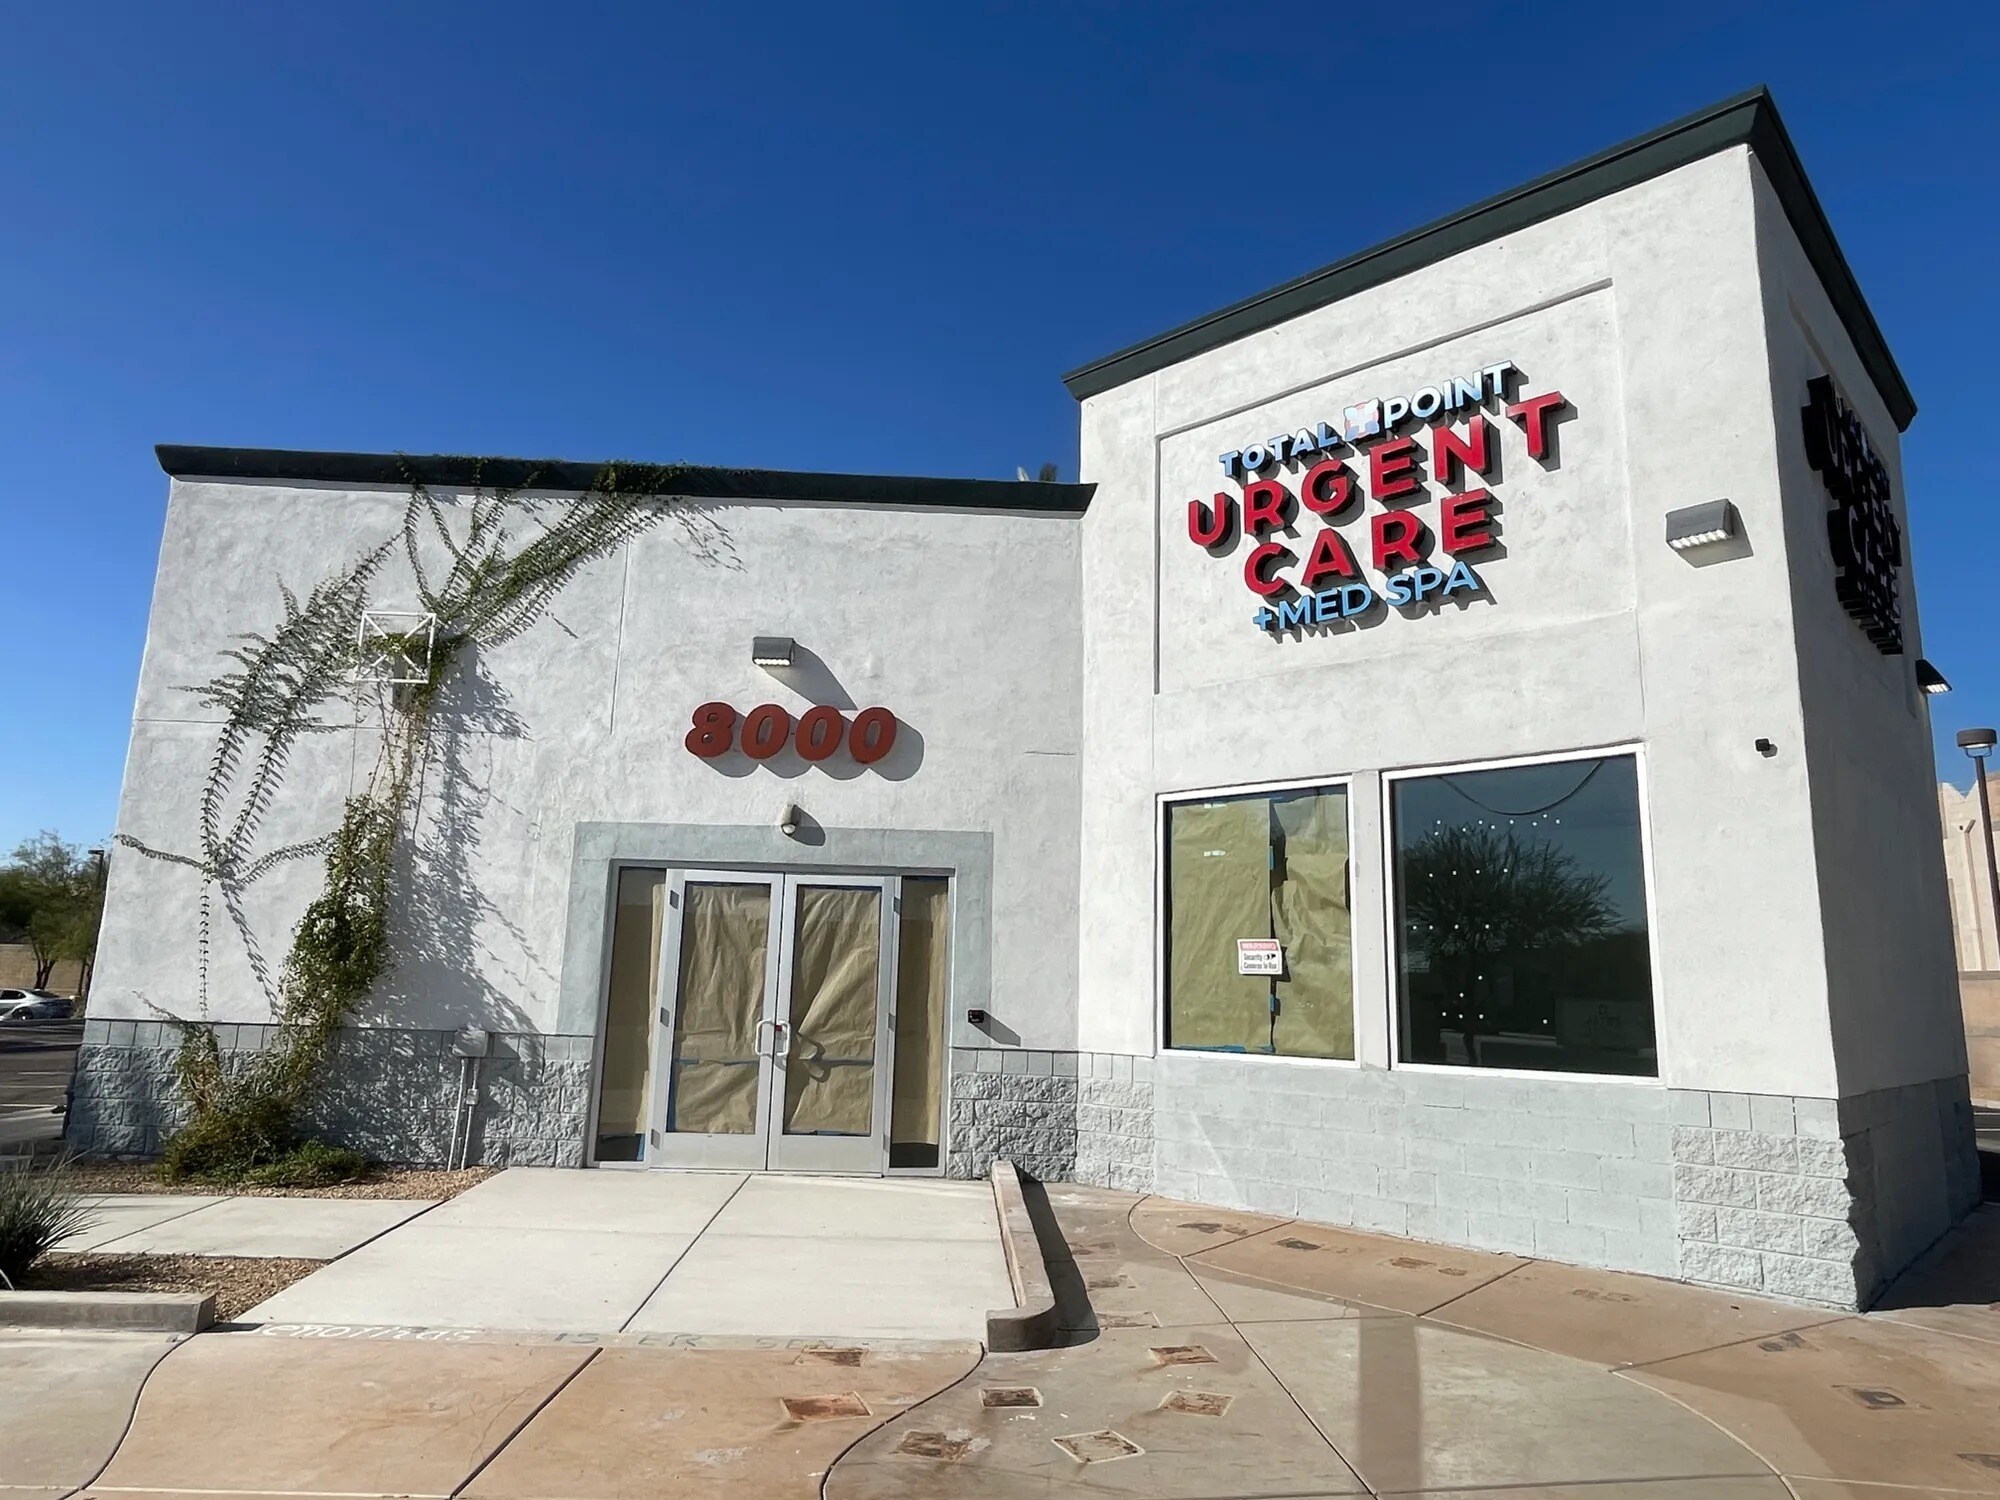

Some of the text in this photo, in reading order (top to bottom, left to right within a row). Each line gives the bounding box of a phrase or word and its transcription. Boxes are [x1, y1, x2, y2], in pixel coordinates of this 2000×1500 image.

[1188, 391, 1566, 549] URGENT
[1218, 360, 1517, 478] TOTAL POINT
[1244, 486, 1496, 597] CARE
[1385, 560, 1480, 607] SPA
[684, 701, 897, 765] 8000
